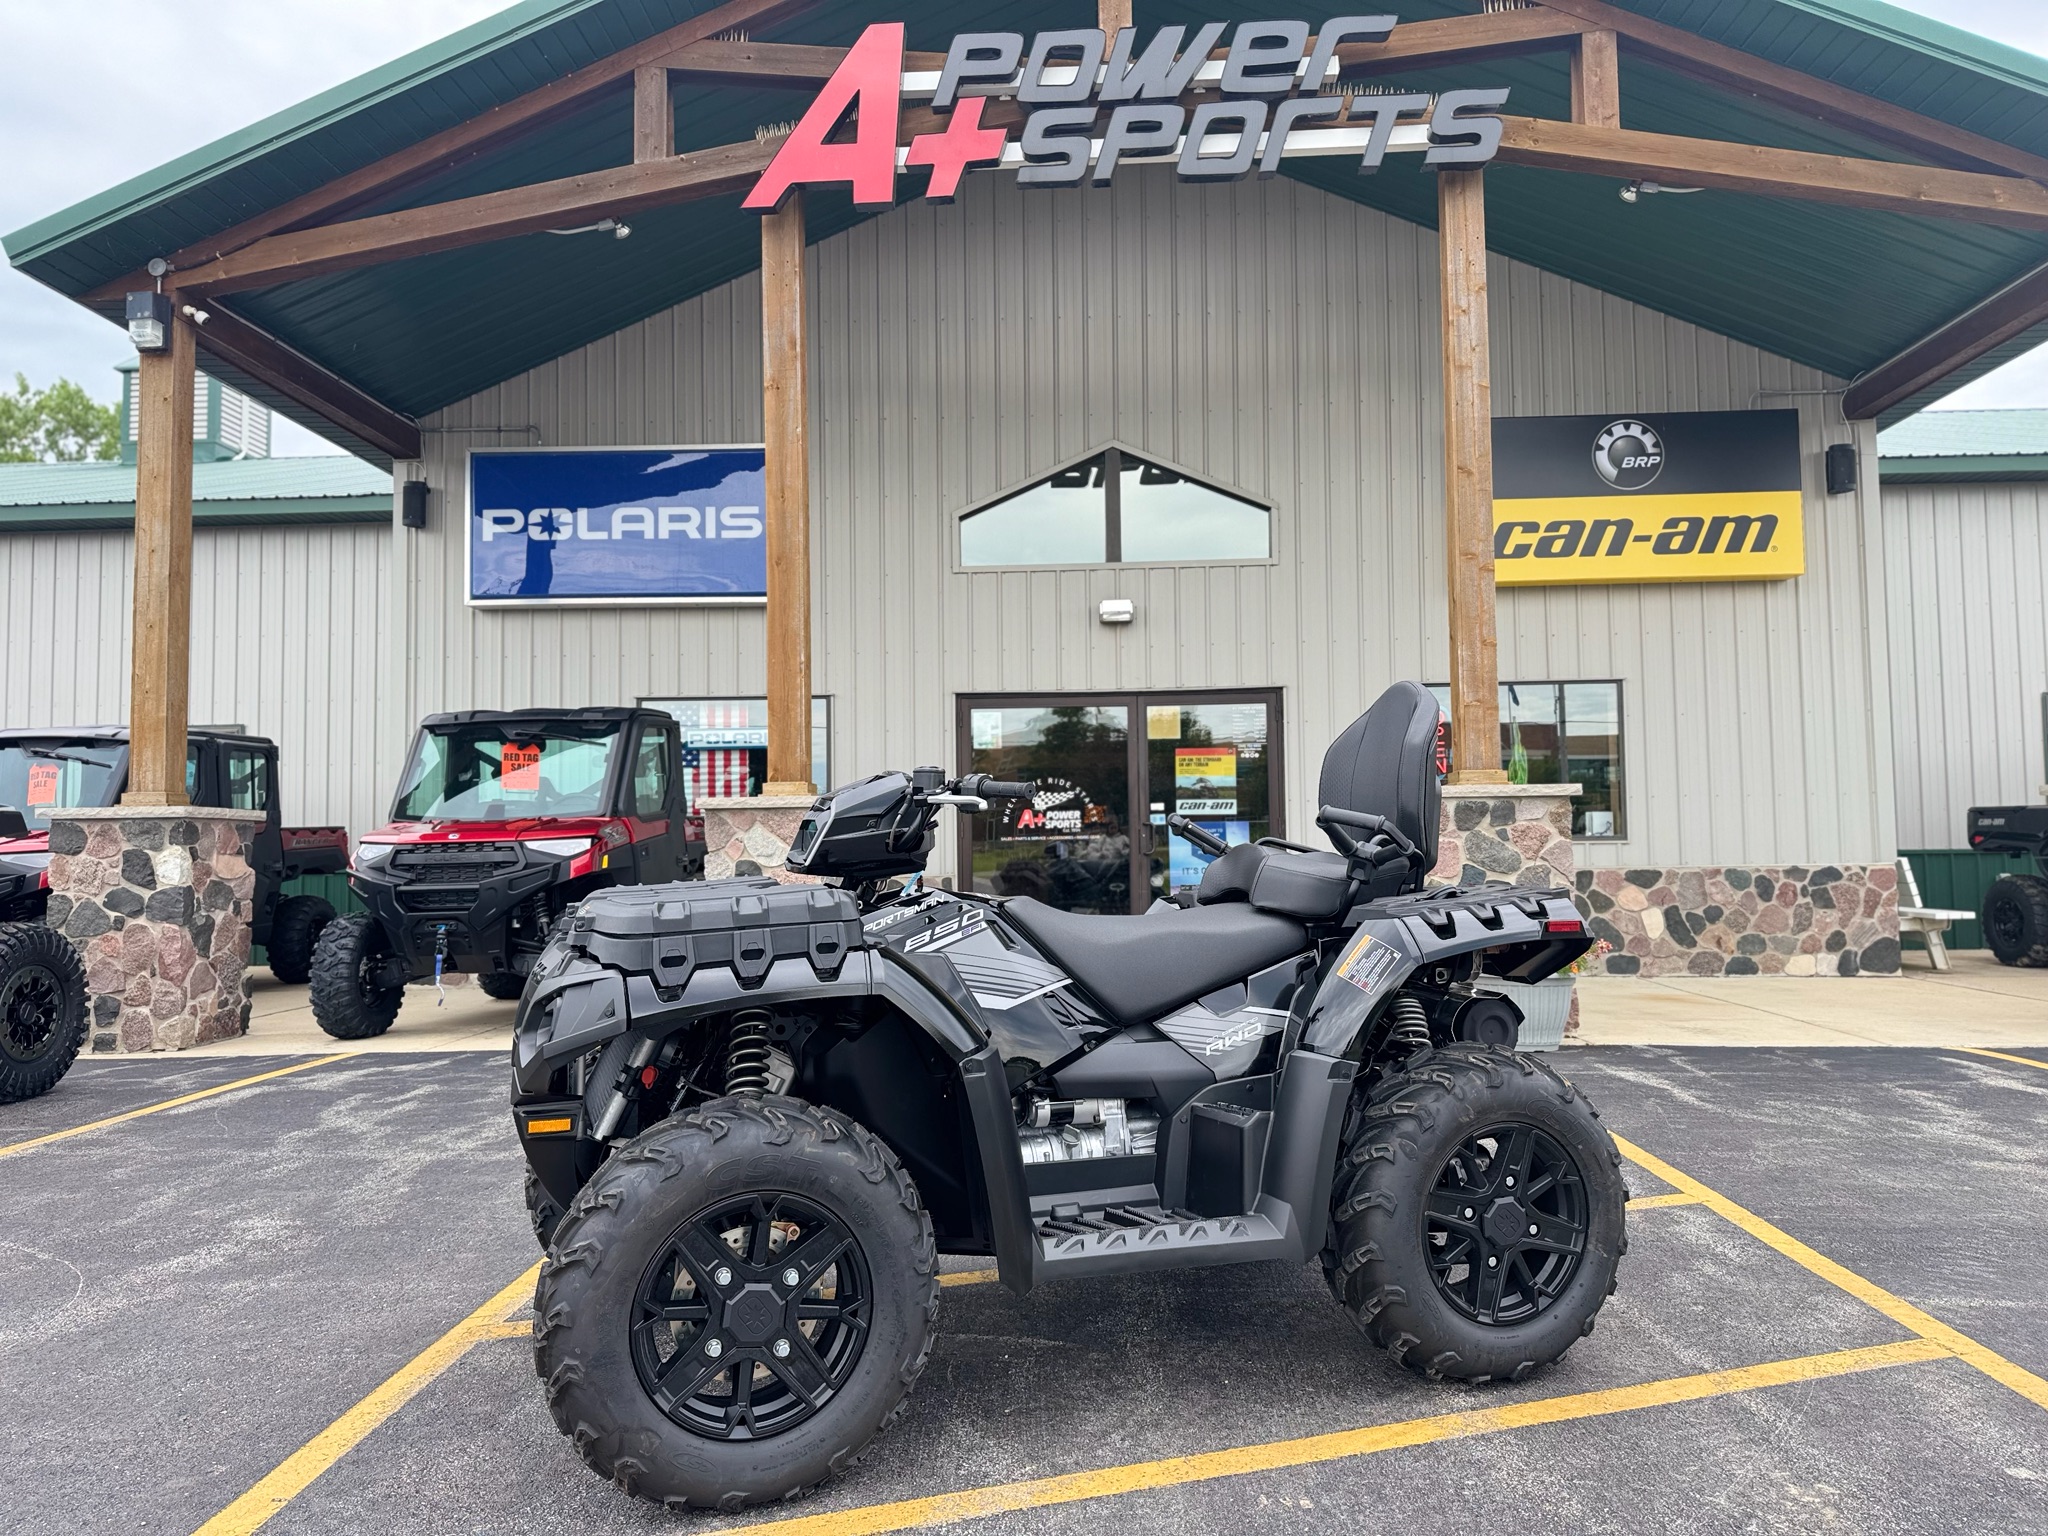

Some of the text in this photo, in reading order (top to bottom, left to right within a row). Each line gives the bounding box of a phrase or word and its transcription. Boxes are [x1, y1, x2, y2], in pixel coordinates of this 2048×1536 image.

[1621, 455, 1661, 469] BRP
[482, 505, 763, 541] POLARIS
[690, 732, 768, 745] POLARI
[504, 753, 539, 762] RED TAG
[511, 763, 531, 772] SALE
[41, 771, 57, 780] TAG
[33, 780, 48, 789] SALE
[1048, 777, 1072, 788] RIDE
[1017, 808, 1082, 829] A+ POWER
[1045, 820, 1082, 829] SPORTS
[1182, 867, 1199, 876] IT'S
[863, 894, 945, 932] PORTSMAN
[903, 908, 984, 953] 850
[1205, 1022, 1262, 1057] AWD
[704, 1152, 823, 1191] CST
